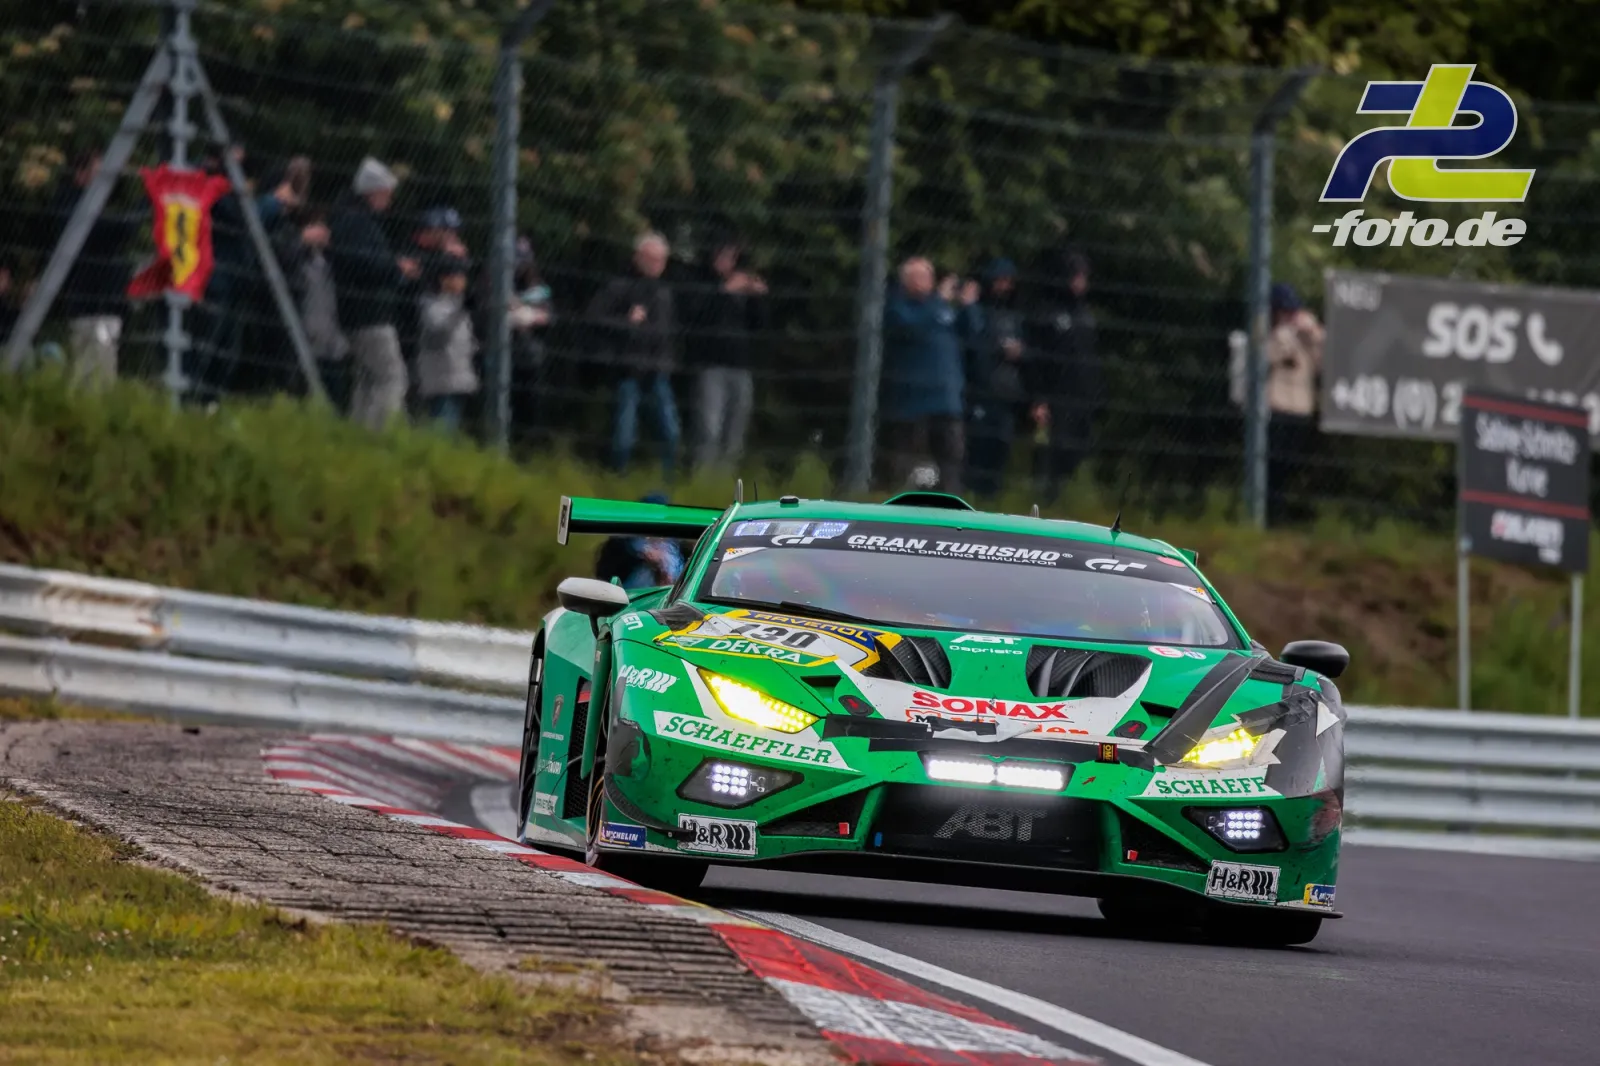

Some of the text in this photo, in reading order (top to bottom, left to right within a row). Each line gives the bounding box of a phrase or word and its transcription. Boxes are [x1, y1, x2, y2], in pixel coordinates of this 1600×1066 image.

[1422, 302, 1521, 363] SOS
[847, 534, 928, 550] GRAN
[880, 546, 915, 554] REAL
[918, 549, 973, 559] DRIVING
[977, 554, 1057, 566] SIMULATOR
[752, 613, 868, 642] RAVENOL
[950, 633, 1022, 645] ABT
[708, 639, 801, 663] DEKRA
[912, 691, 1069, 720] SONAX
[664, 716, 832, 764] SCHAEFFLER
[1154, 776, 1266, 795] SCHAEFF
[933, 802, 1048, 842] ABT
